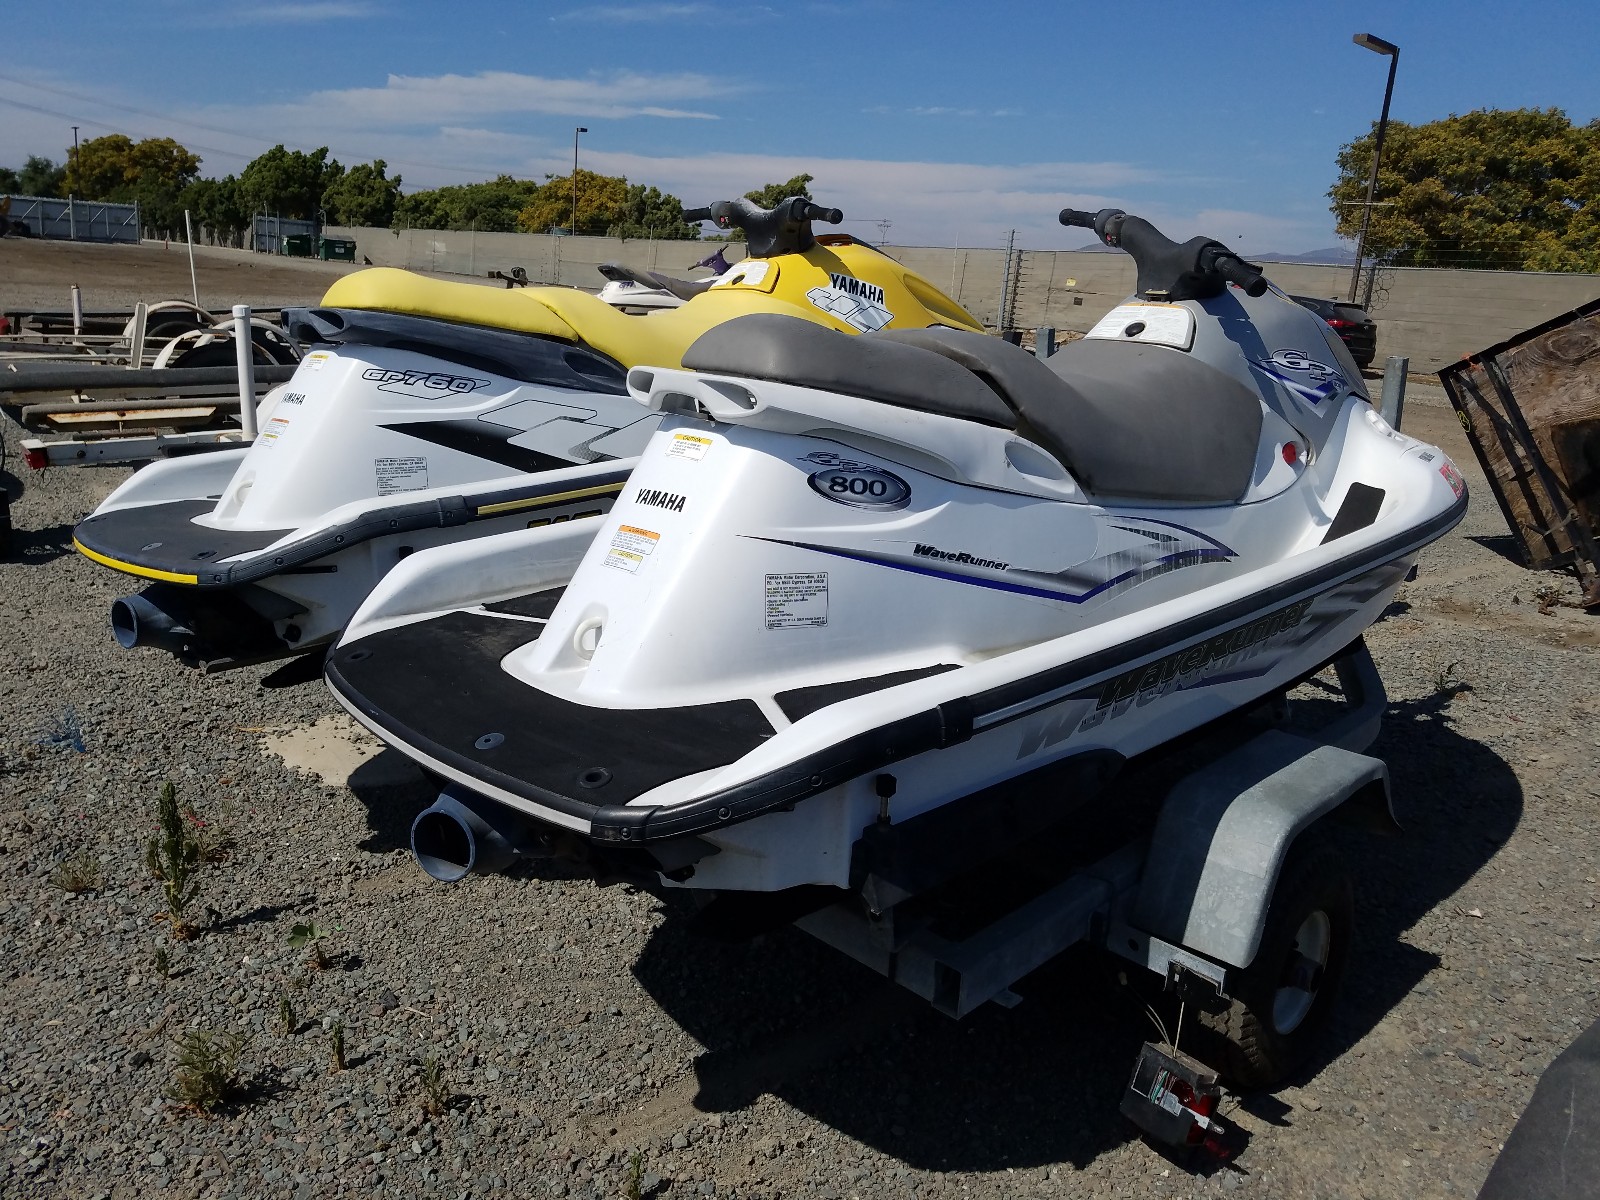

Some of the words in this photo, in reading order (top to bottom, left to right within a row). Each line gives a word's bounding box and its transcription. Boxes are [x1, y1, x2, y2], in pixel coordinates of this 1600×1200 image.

[830, 273, 884, 304] YAMAHA
[362, 368, 477, 393] GP760
[281, 392, 306, 406] YAMAHA
[828, 476, 887, 496] 800
[635, 488, 687, 512] YAMAHA
[913, 544, 1010, 570] WaveRunner
[1096, 600, 1315, 711] WaveRunner
